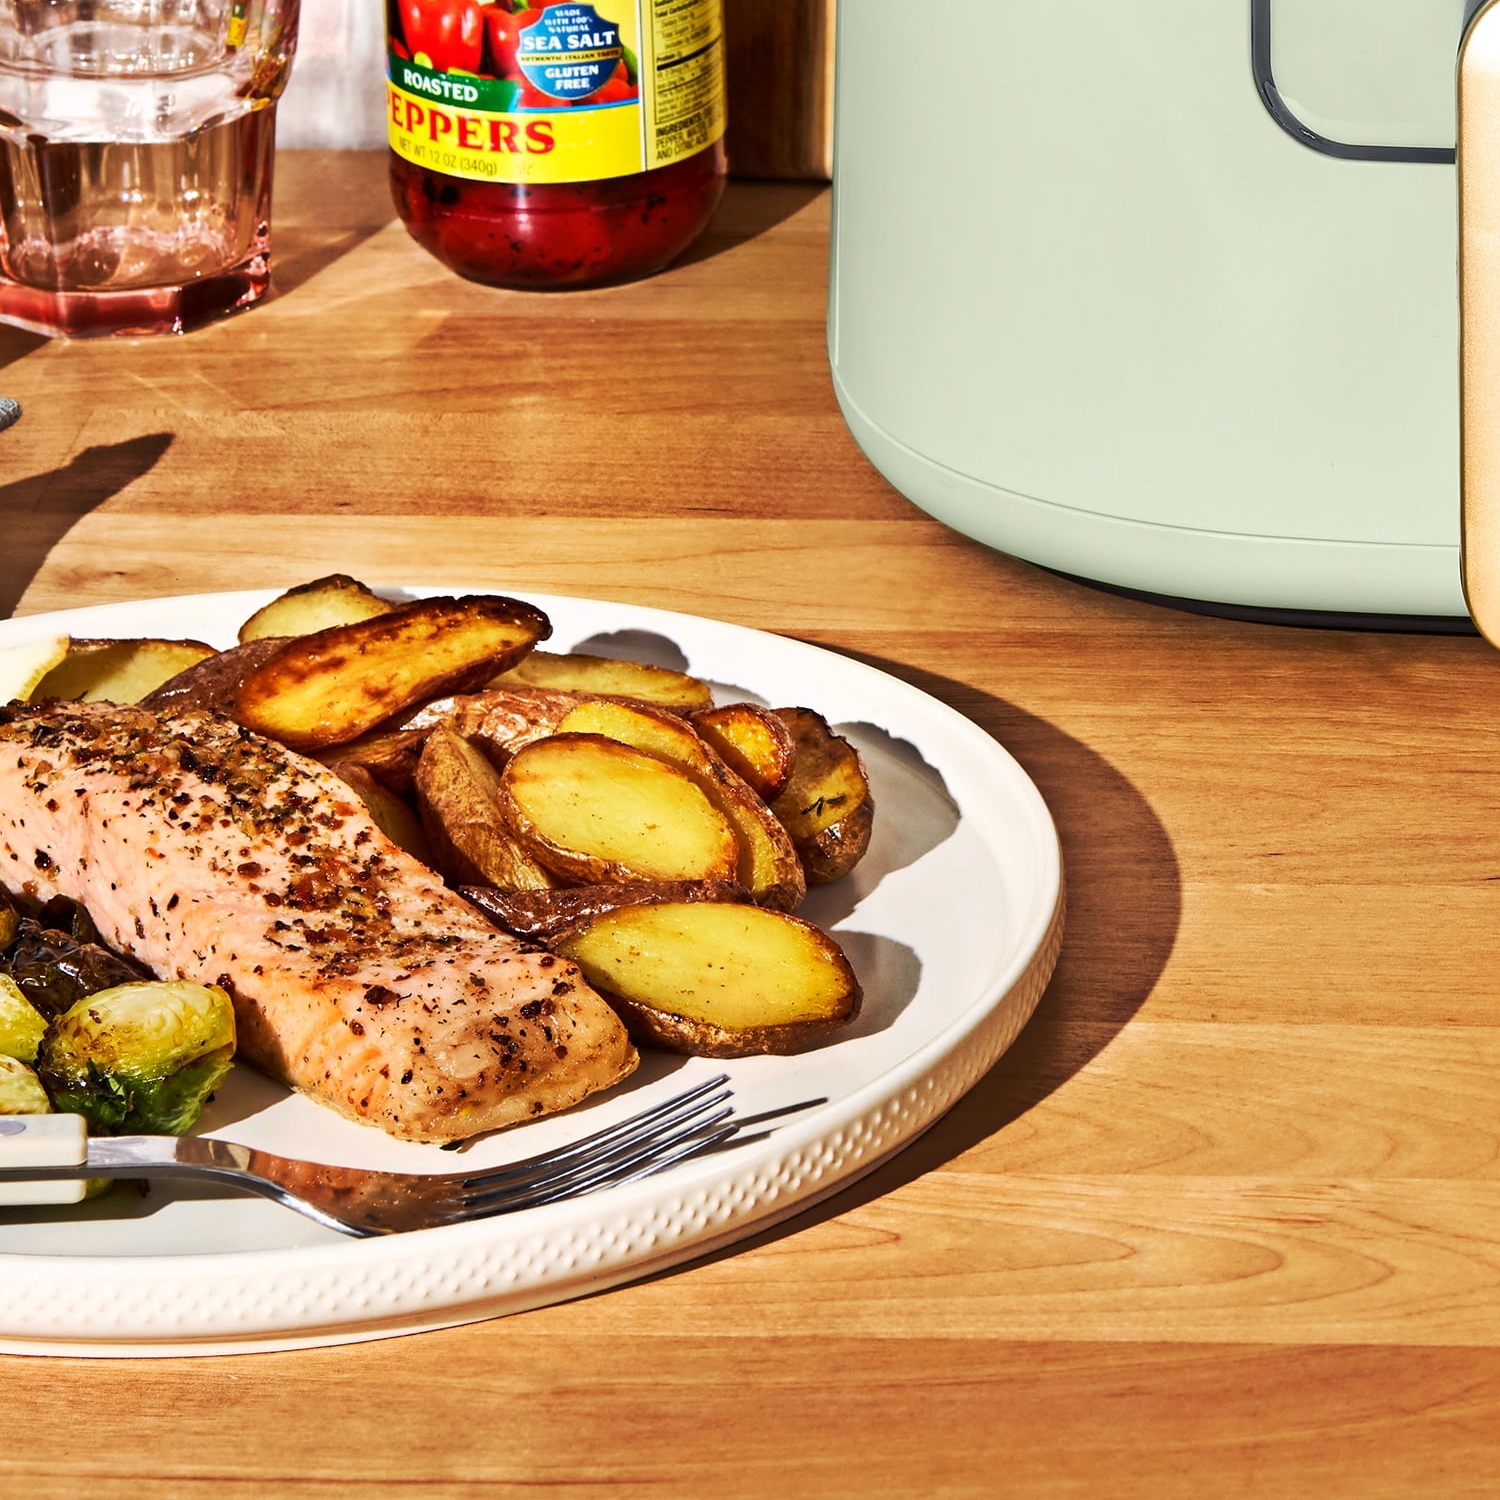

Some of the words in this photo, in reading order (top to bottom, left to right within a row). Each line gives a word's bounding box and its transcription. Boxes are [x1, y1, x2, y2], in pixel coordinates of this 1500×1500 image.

[555, 9, 580, 17] MADE
[544, 17, 569, 26] WITH
[548, 24, 590, 33] NATURAL
[523, 35, 562, 51] SEA
[567, 31, 615, 50] SALT
[545, 64, 599, 79] GLUTEN
[403, 68, 479, 103] ROASTED
[555, 78, 590, 90] FREE
[387, 88, 555, 155] EPPERS
[414, 144, 426, 157] WT
[430, 149, 440, 164] 12
[443, 152, 457, 168] OZ
[460, 157, 498, 177] (340g)
